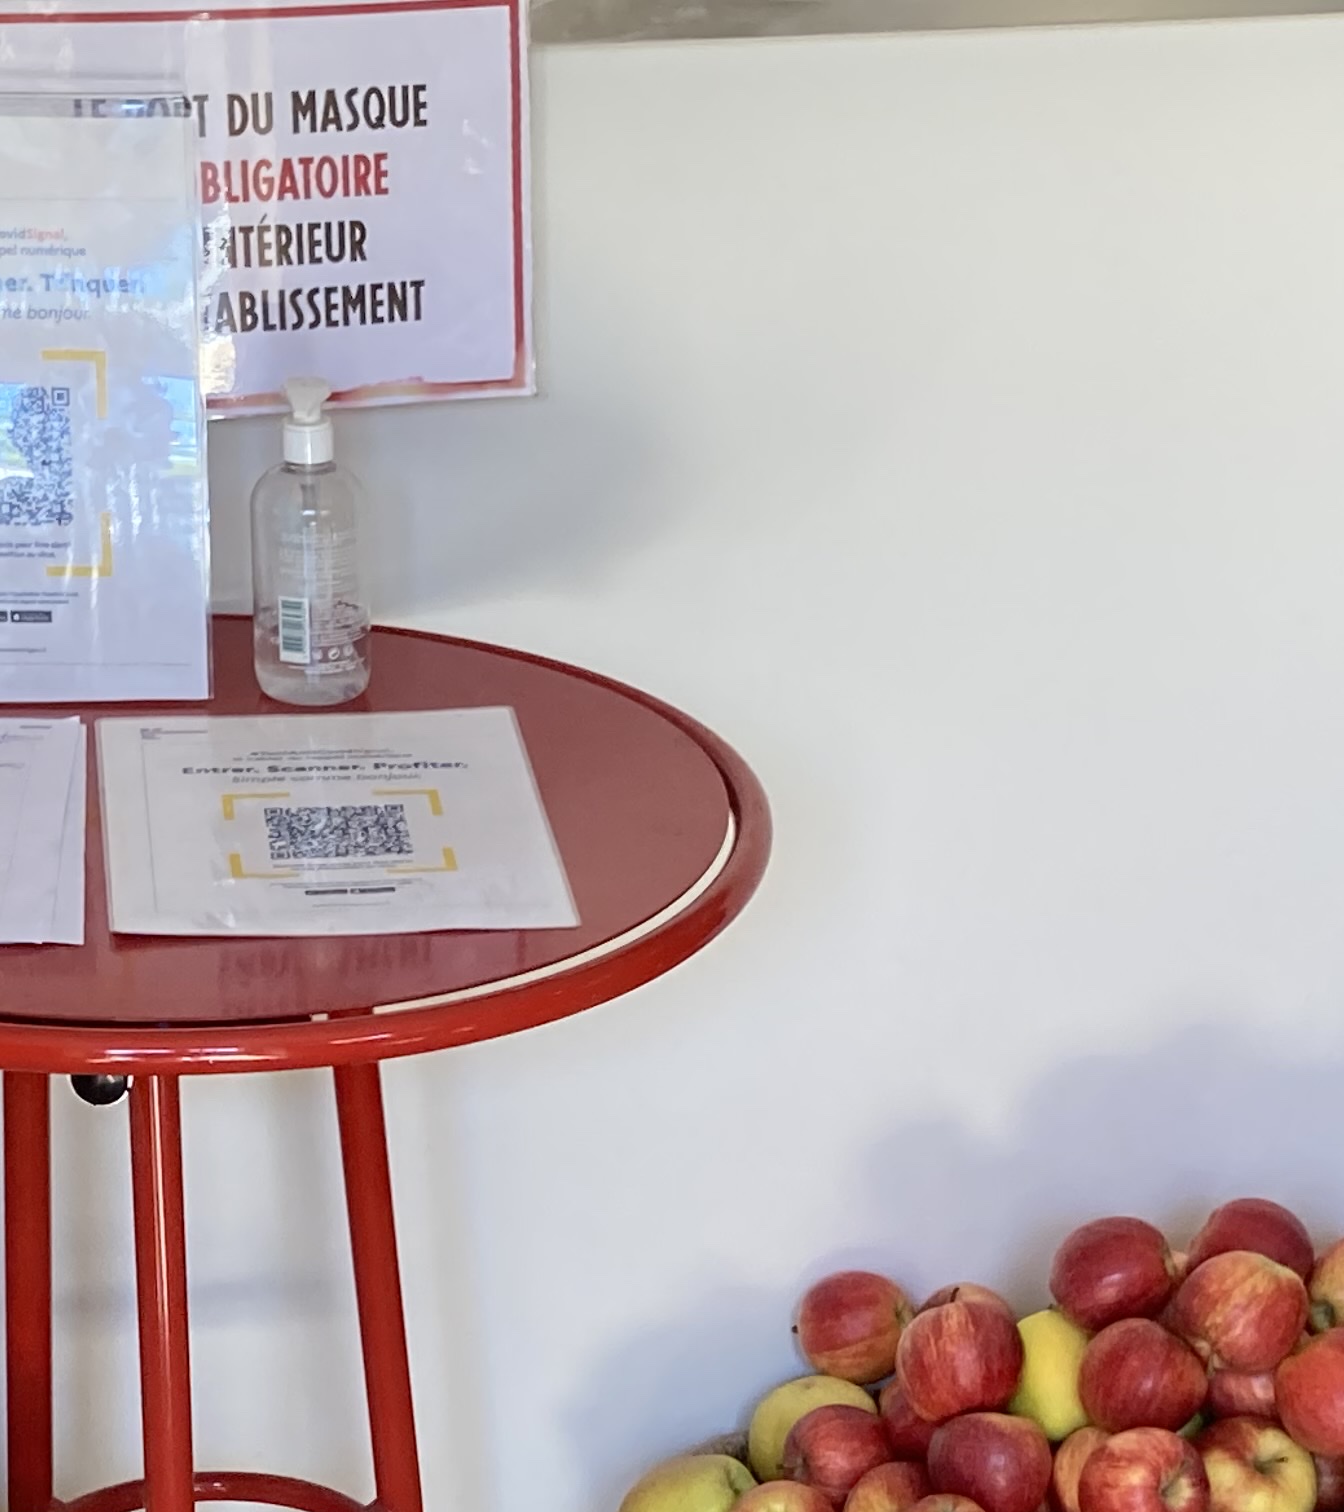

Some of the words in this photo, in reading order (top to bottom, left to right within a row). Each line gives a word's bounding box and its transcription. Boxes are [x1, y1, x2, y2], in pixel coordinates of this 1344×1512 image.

[227, 91, 273, 137] DU
[291, 84, 428, 134] MASQUE
[200, 152, 389, 205] BLIGATOIRE
[204, 280, 425, 333] ABLISSEMENT
